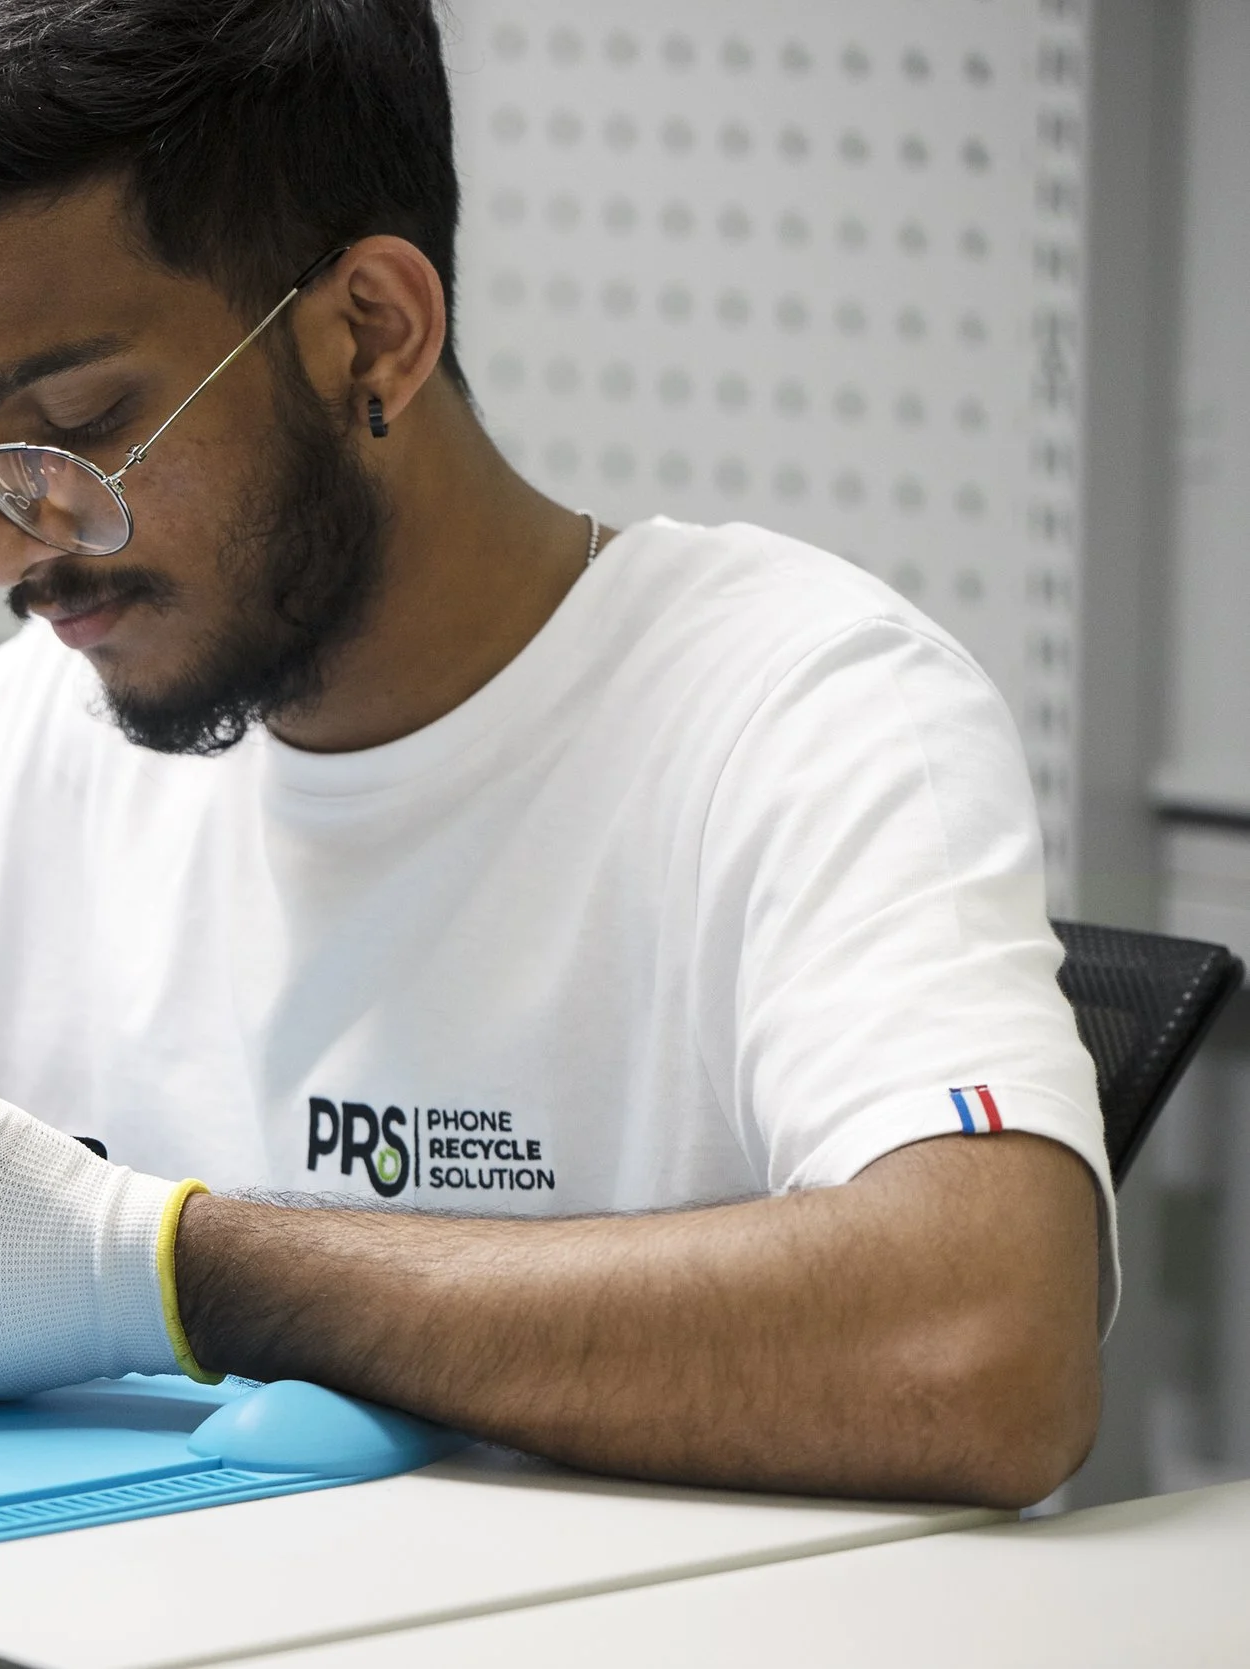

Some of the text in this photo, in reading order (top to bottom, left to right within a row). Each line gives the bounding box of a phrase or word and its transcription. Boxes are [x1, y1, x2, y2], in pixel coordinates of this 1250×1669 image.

[427, 1109, 513, 1132] PHONE
[307, 1096, 410, 1198] PRS
[429, 1138, 542, 1161] RECYCLE
[429, 1167, 555, 1190] SOLUTION
